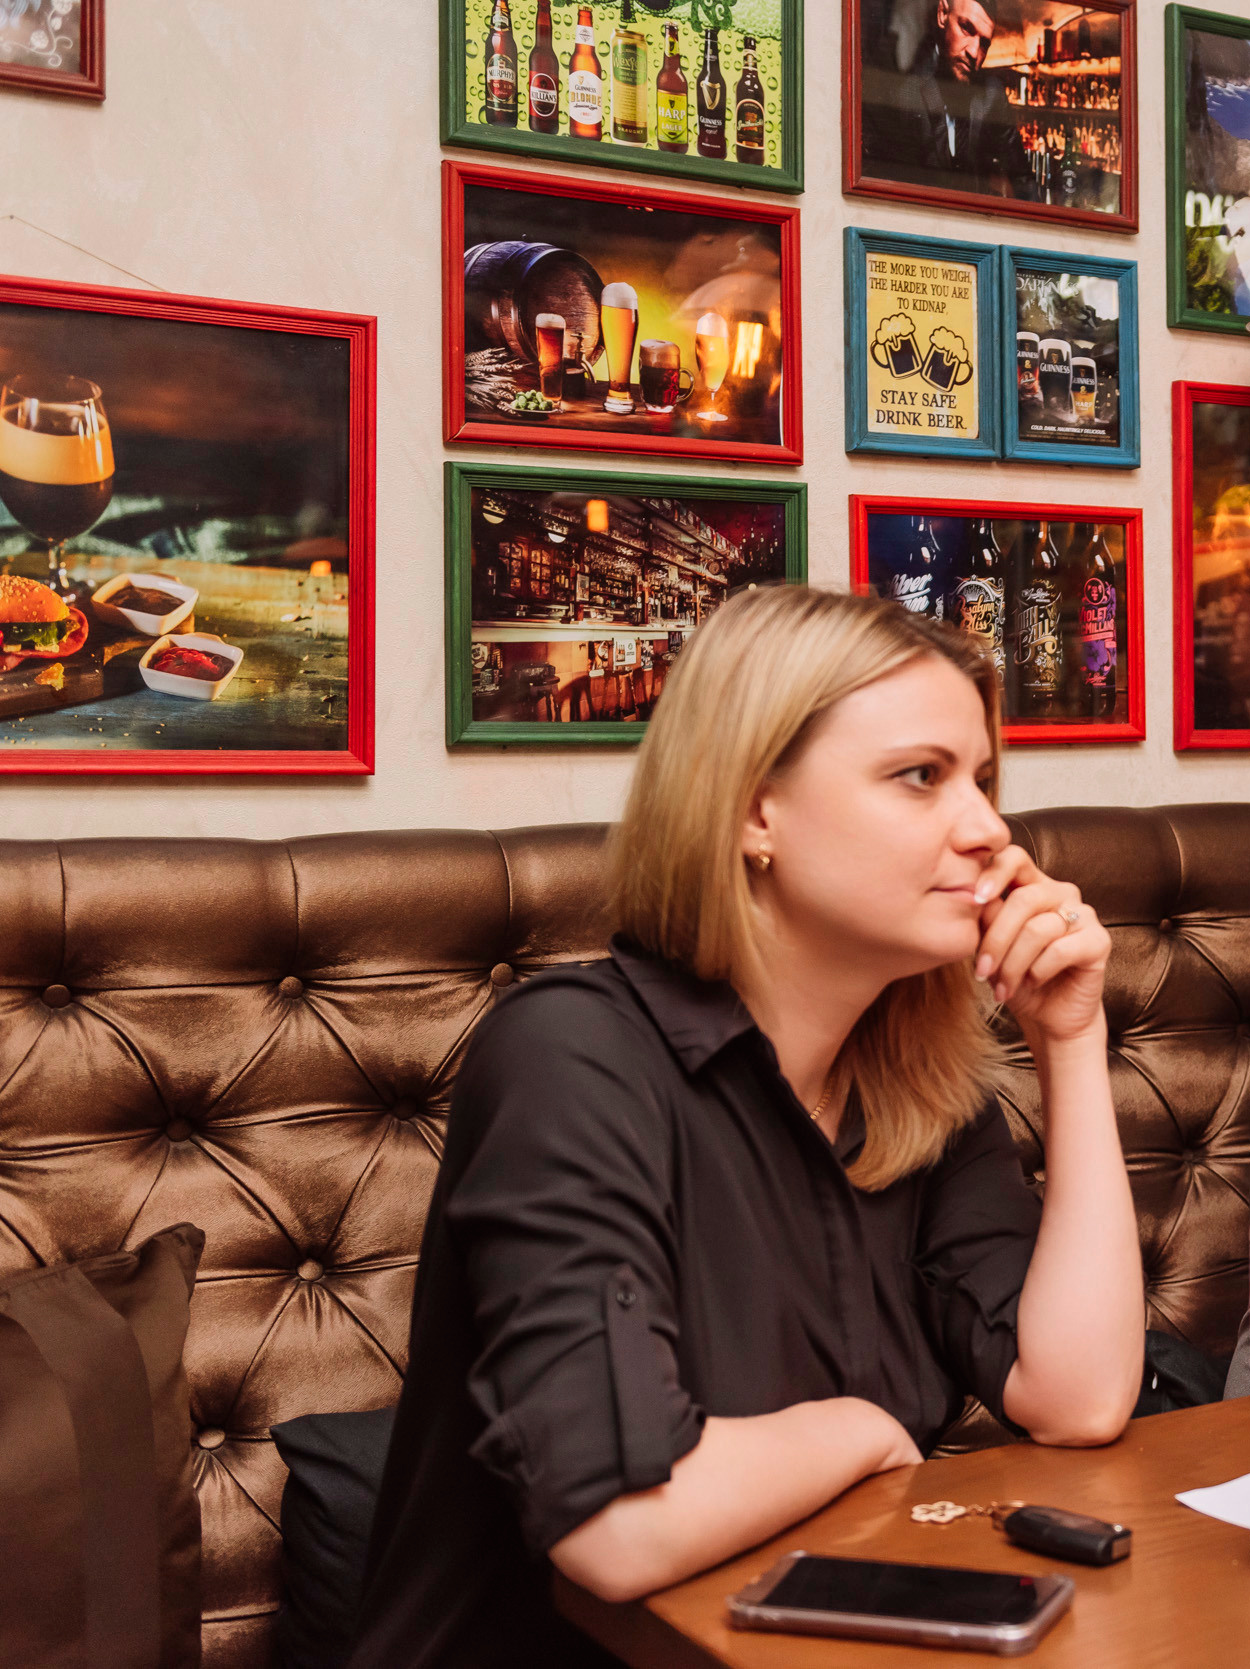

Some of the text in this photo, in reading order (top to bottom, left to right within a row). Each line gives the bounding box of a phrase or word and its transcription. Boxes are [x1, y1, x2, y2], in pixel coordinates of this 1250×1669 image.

[574, 84, 597, 94] GUINNESS
[570, 91, 602, 108] BLONDE
[658, 106, 686, 120] HARP
[661, 122, 683, 132] LAGER
[699, 115, 723, 127] GUINNESS
[617, 127, 643, 136] DRAUGHT
[869, 260, 972, 285] THE MORE YOU WEIGH,
[869, 277, 969, 299] THE HARDER YOU ARE
[897, 297, 910, 310] TO
[1016, 350, 1039, 360] GUINNESS
[1040, 362, 1070, 374] GUINNESS
[880, 389, 957, 409] STAY SAFE
[876, 409, 967, 430] DRINK BEER.
